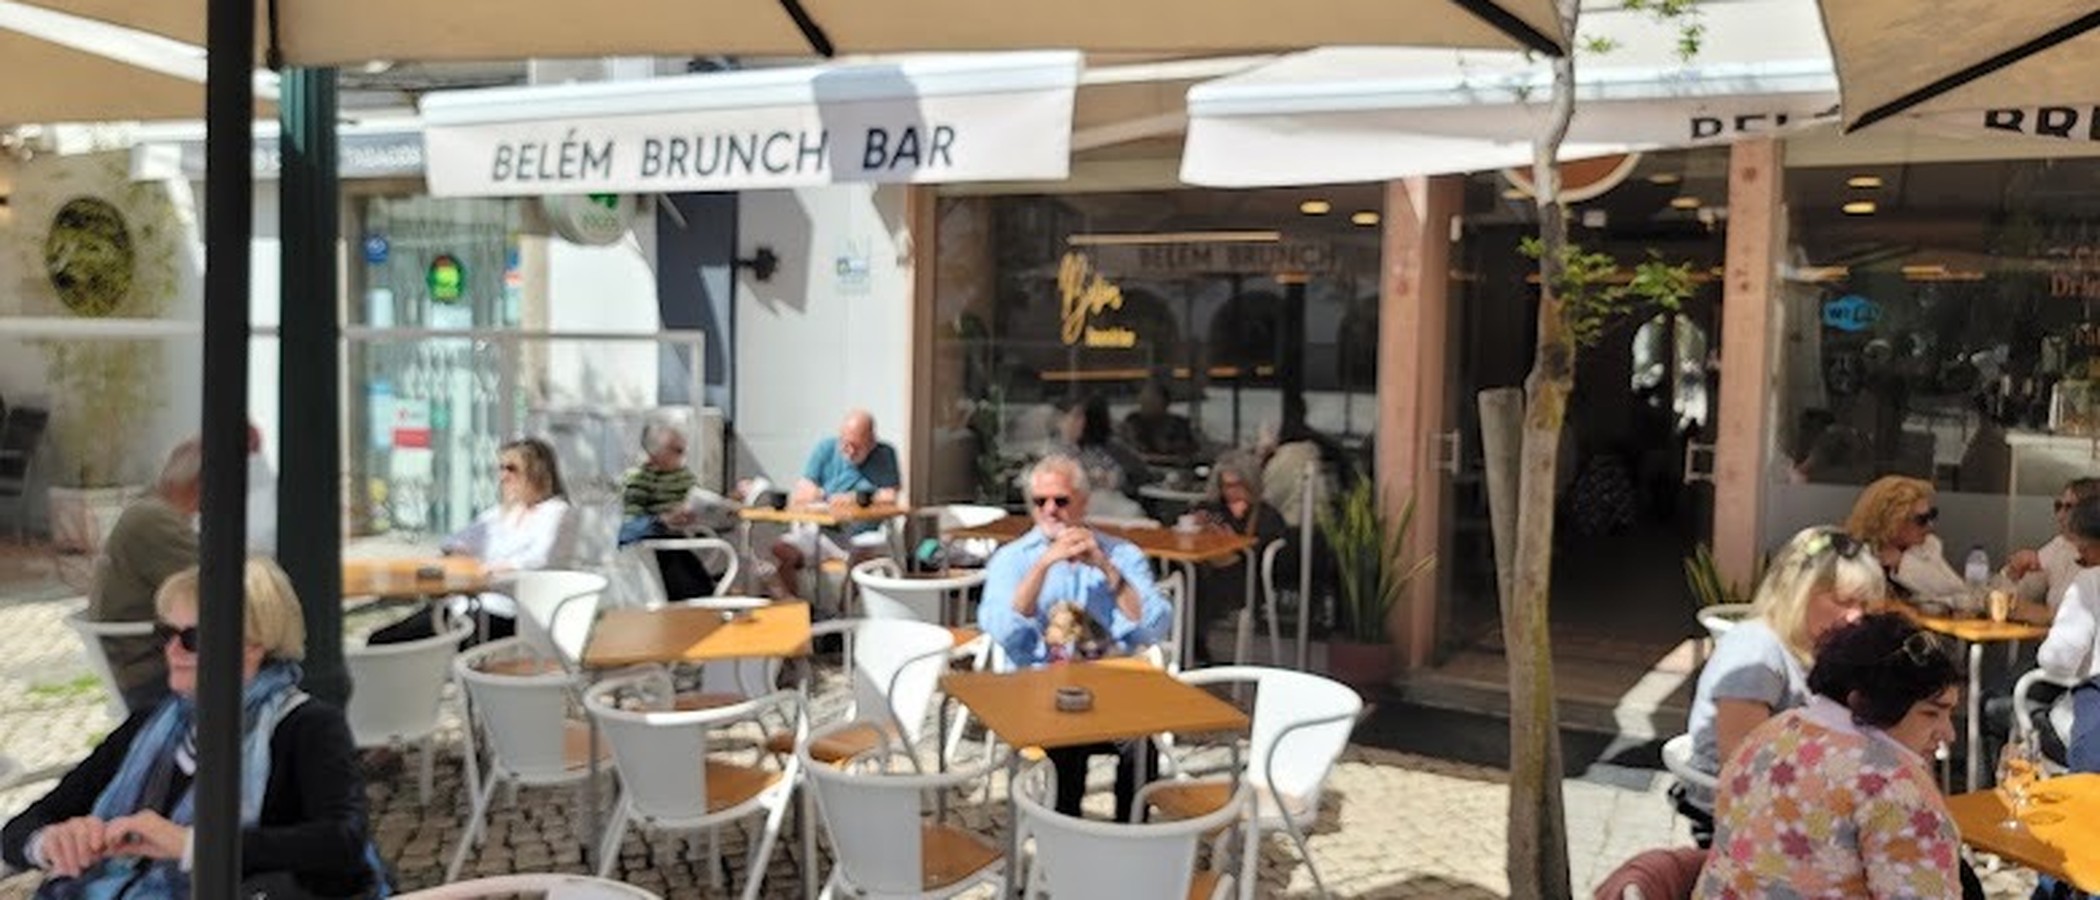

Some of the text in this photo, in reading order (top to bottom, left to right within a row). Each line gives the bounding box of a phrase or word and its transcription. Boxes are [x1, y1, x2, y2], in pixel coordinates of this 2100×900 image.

[492, 125, 956, 181] BELÉM BRUNCH BAR
